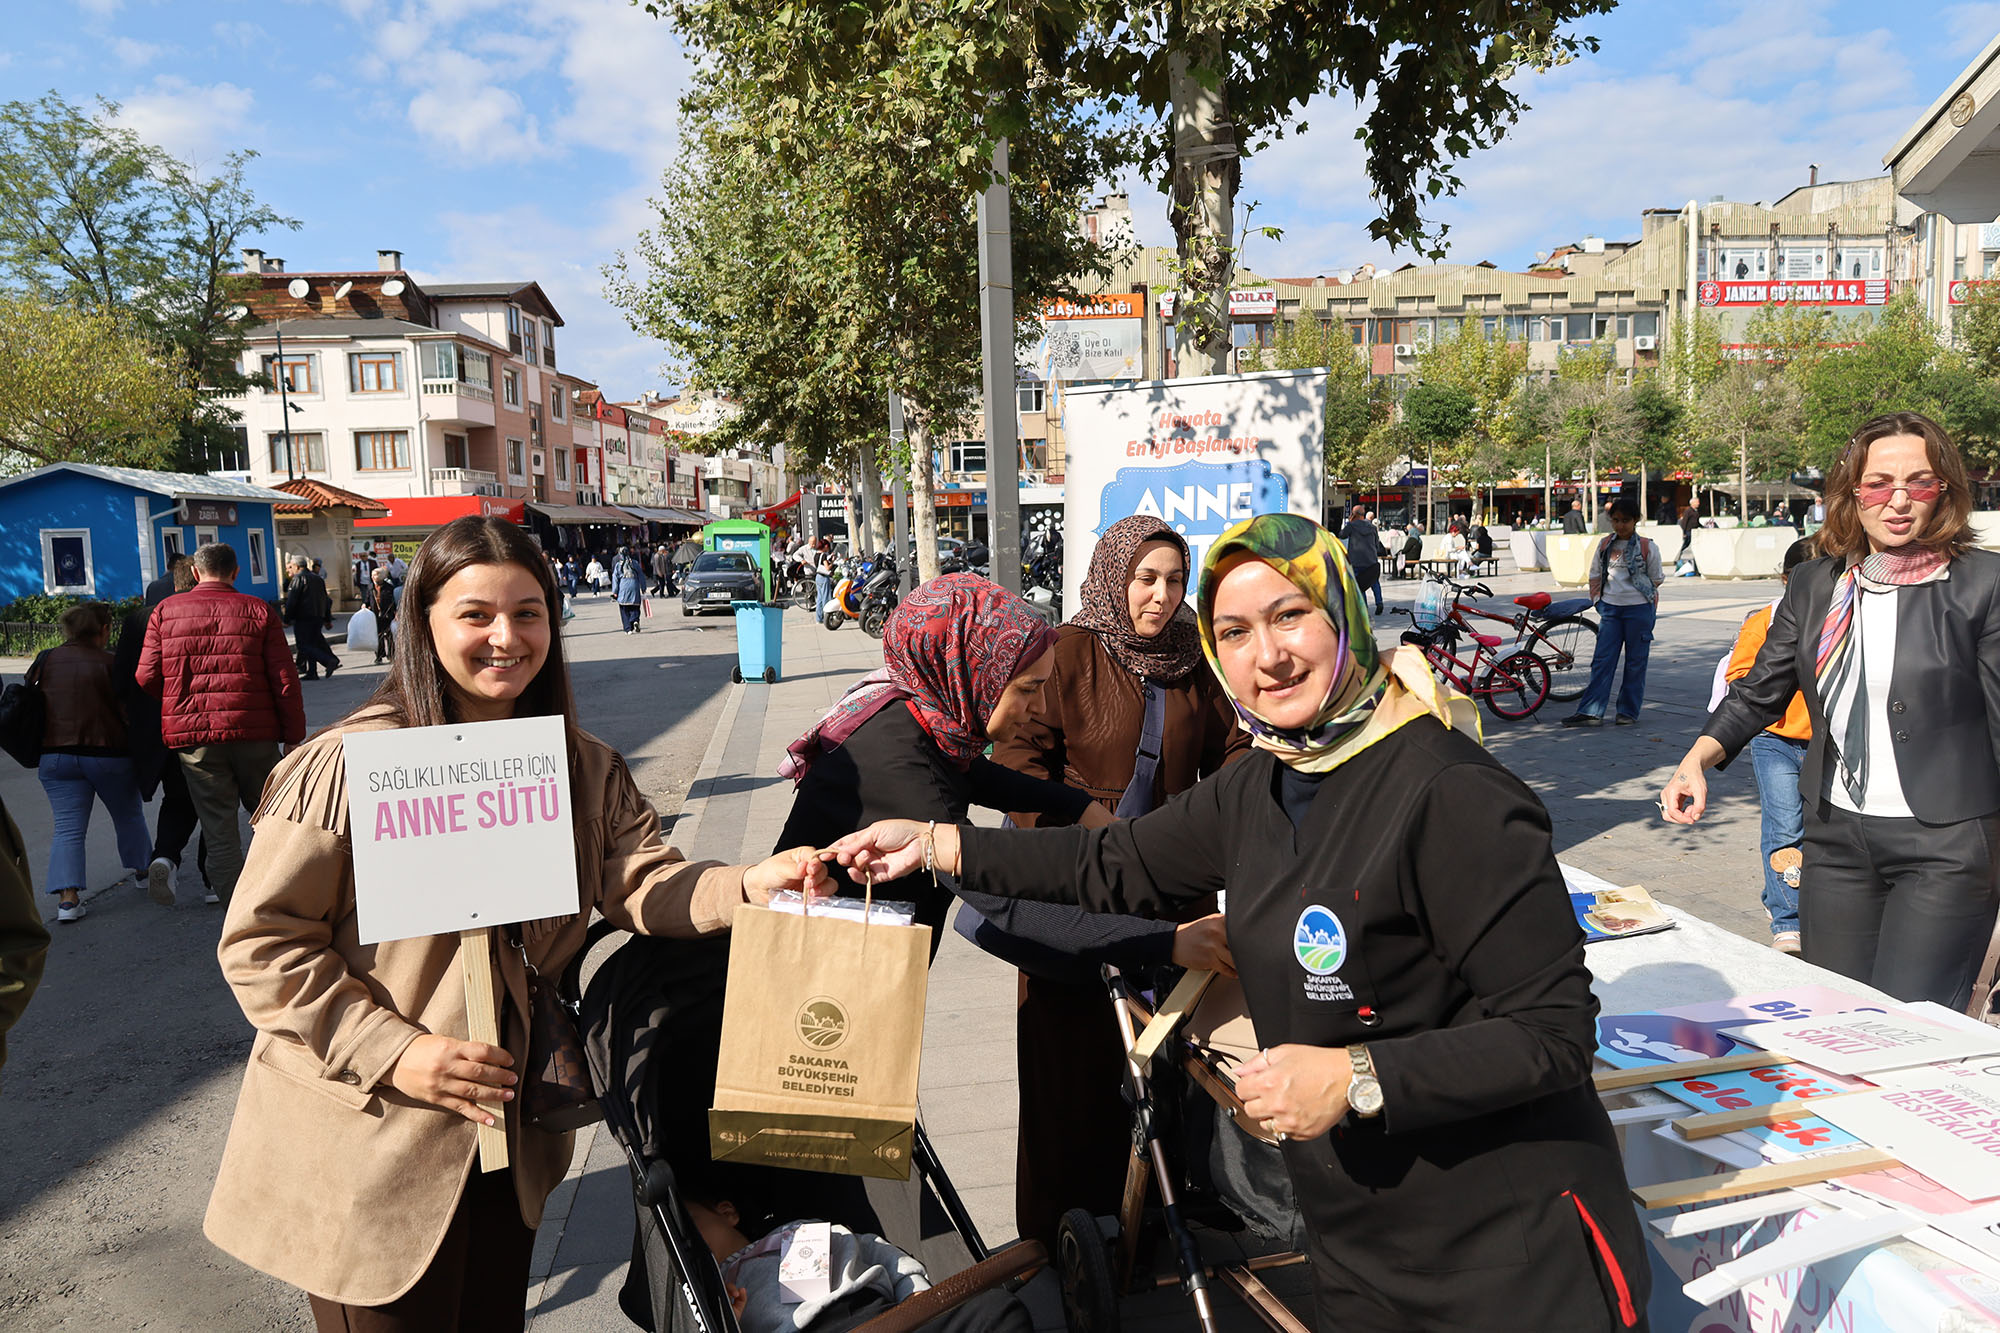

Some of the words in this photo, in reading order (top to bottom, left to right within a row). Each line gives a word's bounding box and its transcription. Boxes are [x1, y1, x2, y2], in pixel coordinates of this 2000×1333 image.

[1724, 285, 1767, 302] JANEM
[1769, 281, 1833, 302] GÜVENLİK
[1836, 285, 1861, 304] A.Ş.
[1047, 300, 1131, 318] BAŞKANLIĞI
[1084, 337, 1100, 349] Üye
[1102, 338, 1111, 347] Ol
[1084, 349, 1102, 358] Bize
[1159, 409, 1222, 431] Hayata
[1126, 440, 1146, 457] En
[1147, 434, 1172, 459] İyi
[1174, 436, 1259, 457] Başlangıç
[821, 499, 845, 508] HALK
[1133, 482, 1253, 522] ANNE
[819, 509, 844, 518] EKME
[368, 765, 445, 793] SAĞLIKLI
[448, 757, 524, 784] NESİLLER
[527, 752, 557, 780] İÇİN
[374, 793, 468, 841] ANNE
[476, 777, 560, 829] SÜTÜ
[1306, 974, 1343, 985] SAKARYA
[1783, 1029, 1880, 1055] SAKLI
[788, 1054, 849, 1070] SAKARYA
[777, 1066, 858, 1084] BÜYÜKŞEHİR
[782, 1080, 855, 1097] BELEDİYESİ
[1909, 1088, 1993, 1120] ANNE
[1879, 1091, 2000, 1158] DESTEKLİYO
